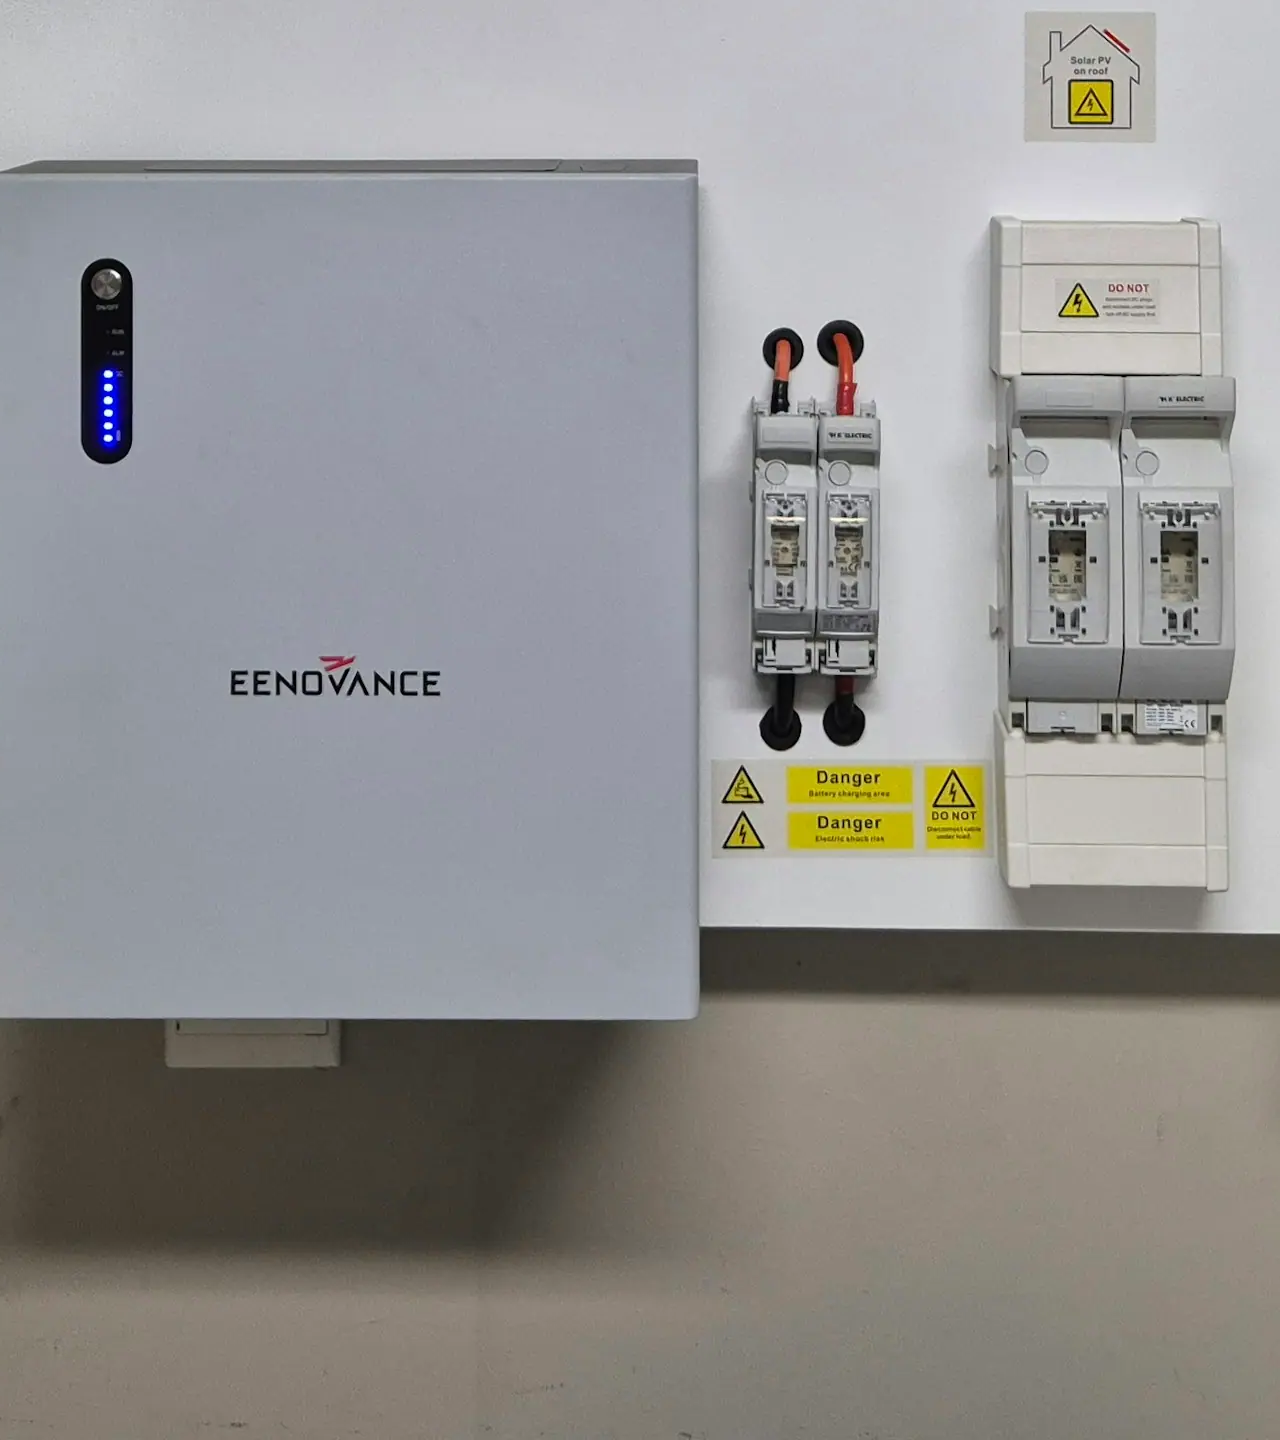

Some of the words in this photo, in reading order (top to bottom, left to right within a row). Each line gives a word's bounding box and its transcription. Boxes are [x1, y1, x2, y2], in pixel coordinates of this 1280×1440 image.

[1070, 56, 1096, 65] Solar
[1098, 56, 1112, 65] PV
[1088, 67, 1109, 75] roof
[1108, 283, 1125, 293] DO
[1127, 283, 1150, 293] NOT
[230, 667, 442, 697] EENOVANCE
[817, 770, 881, 787] Danger
[808, 790, 837, 798] Battery
[838, 790, 872, 798] charging
[931, 811, 949, 820] DO
[952, 811, 977, 820] NOT
[817, 815, 882, 832] Danger
[815, 835, 846, 843] Electric
